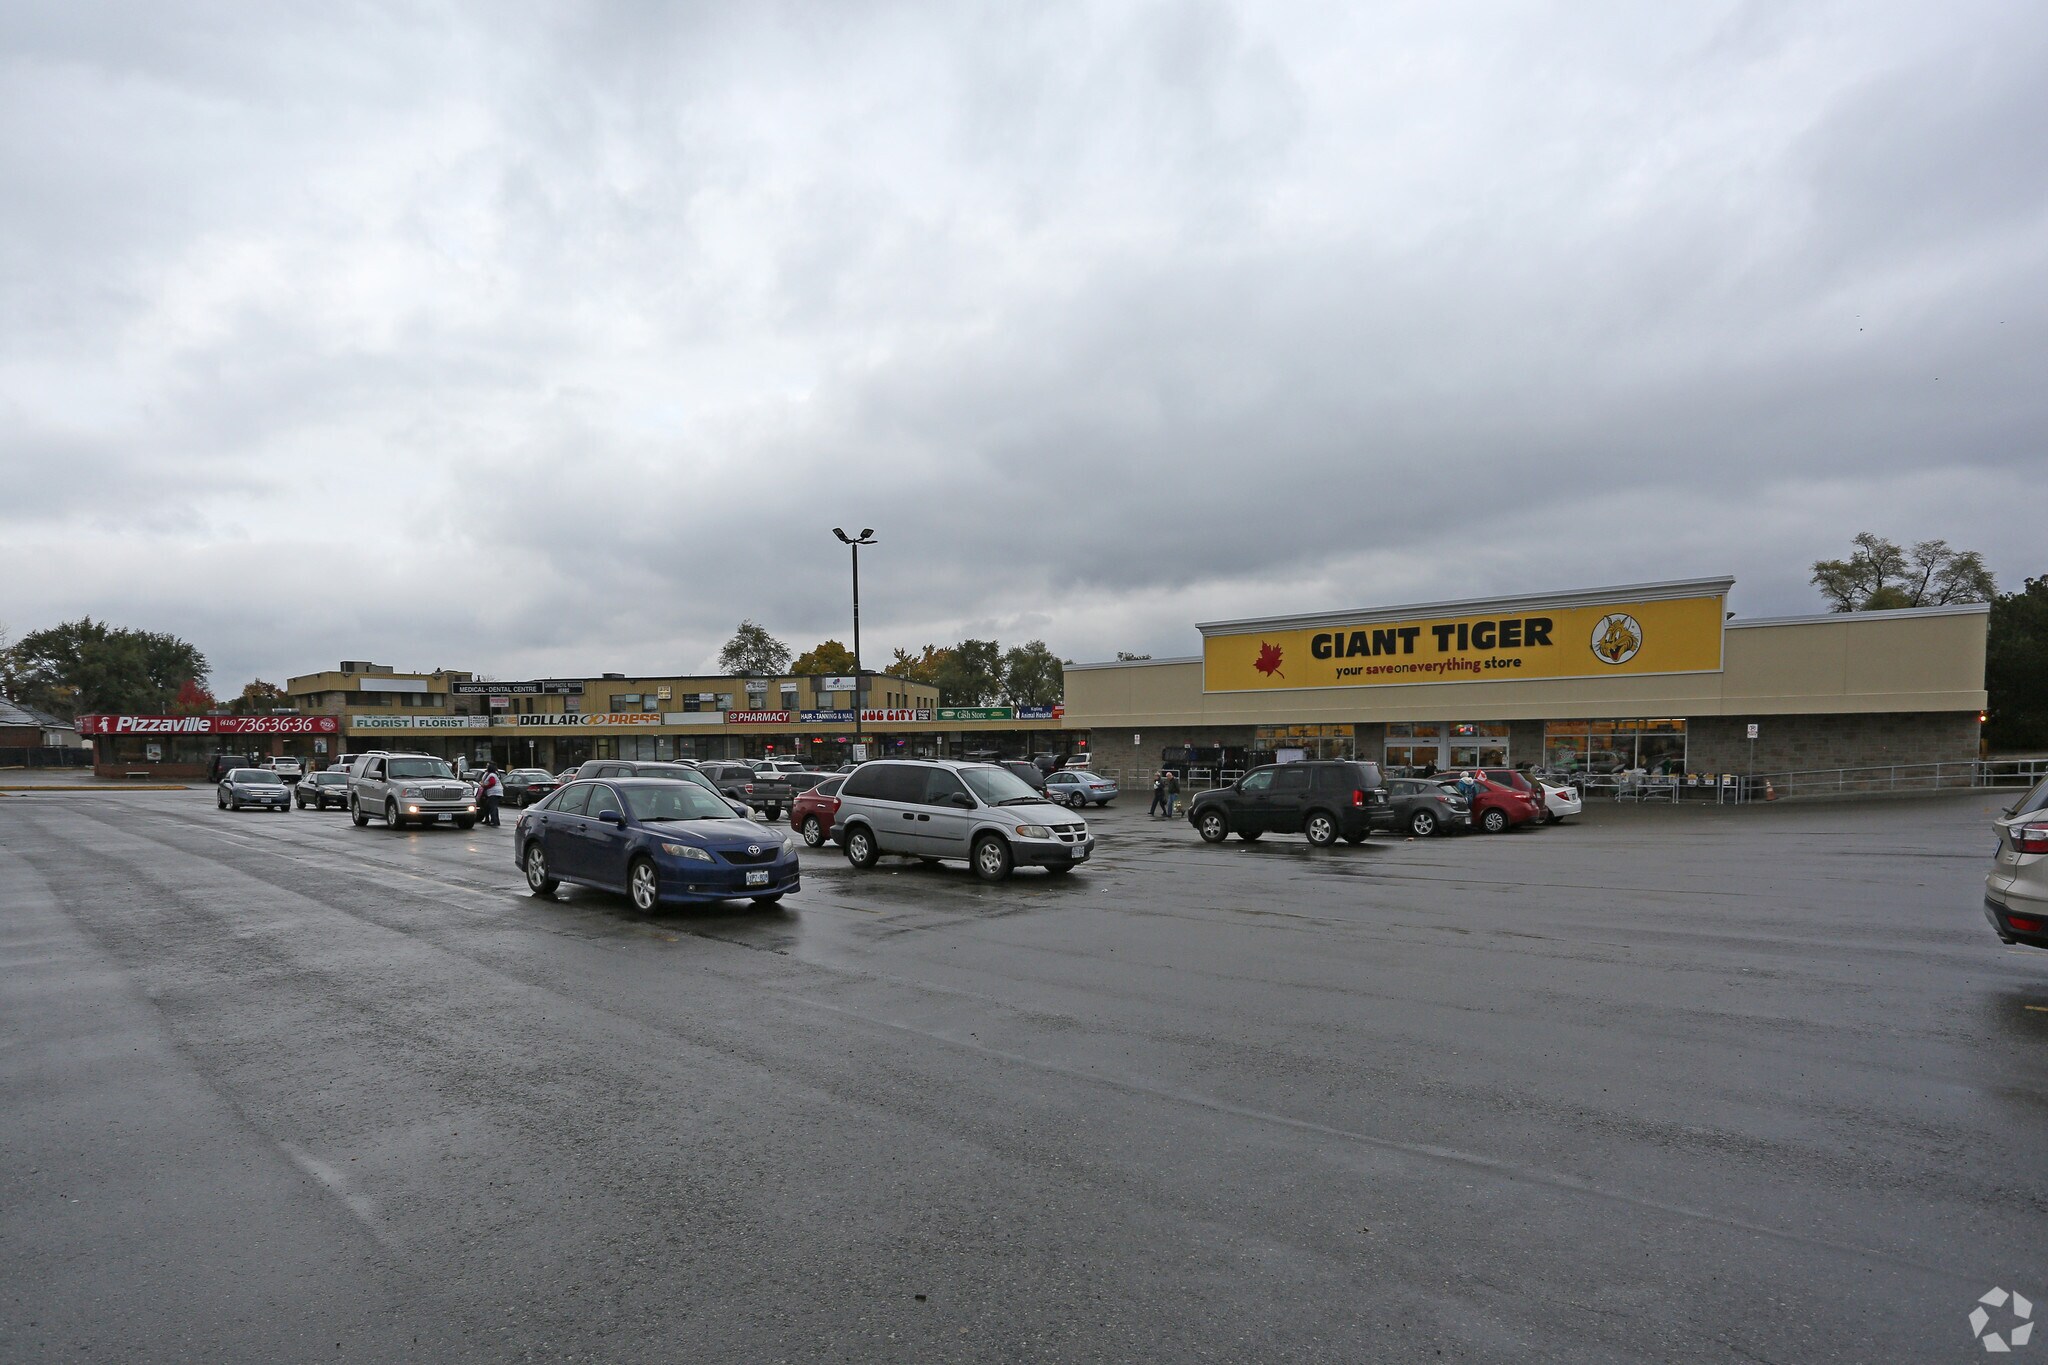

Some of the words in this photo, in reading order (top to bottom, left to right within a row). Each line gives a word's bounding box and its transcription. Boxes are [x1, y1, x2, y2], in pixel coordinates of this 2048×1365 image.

[1311, 627, 1420, 660] GIANT
[1432, 617, 1553, 651] TIGER
[1336, 665, 1363, 679] your
[1484, 656, 1522, 670] store
[520, 714, 579, 725] DOLLAR
[738, 712, 789, 722] PHARMACY
[862, 710, 884, 721] JUG
[887, 710, 914, 721] CITY
[957, 711, 971, 719] Cash
[971, 711, 986, 719] Store
[1036, 712, 1053, 720] Hospital
[116, 717, 211, 732] Pizzaville
[220, 719, 236, 727] (416)
